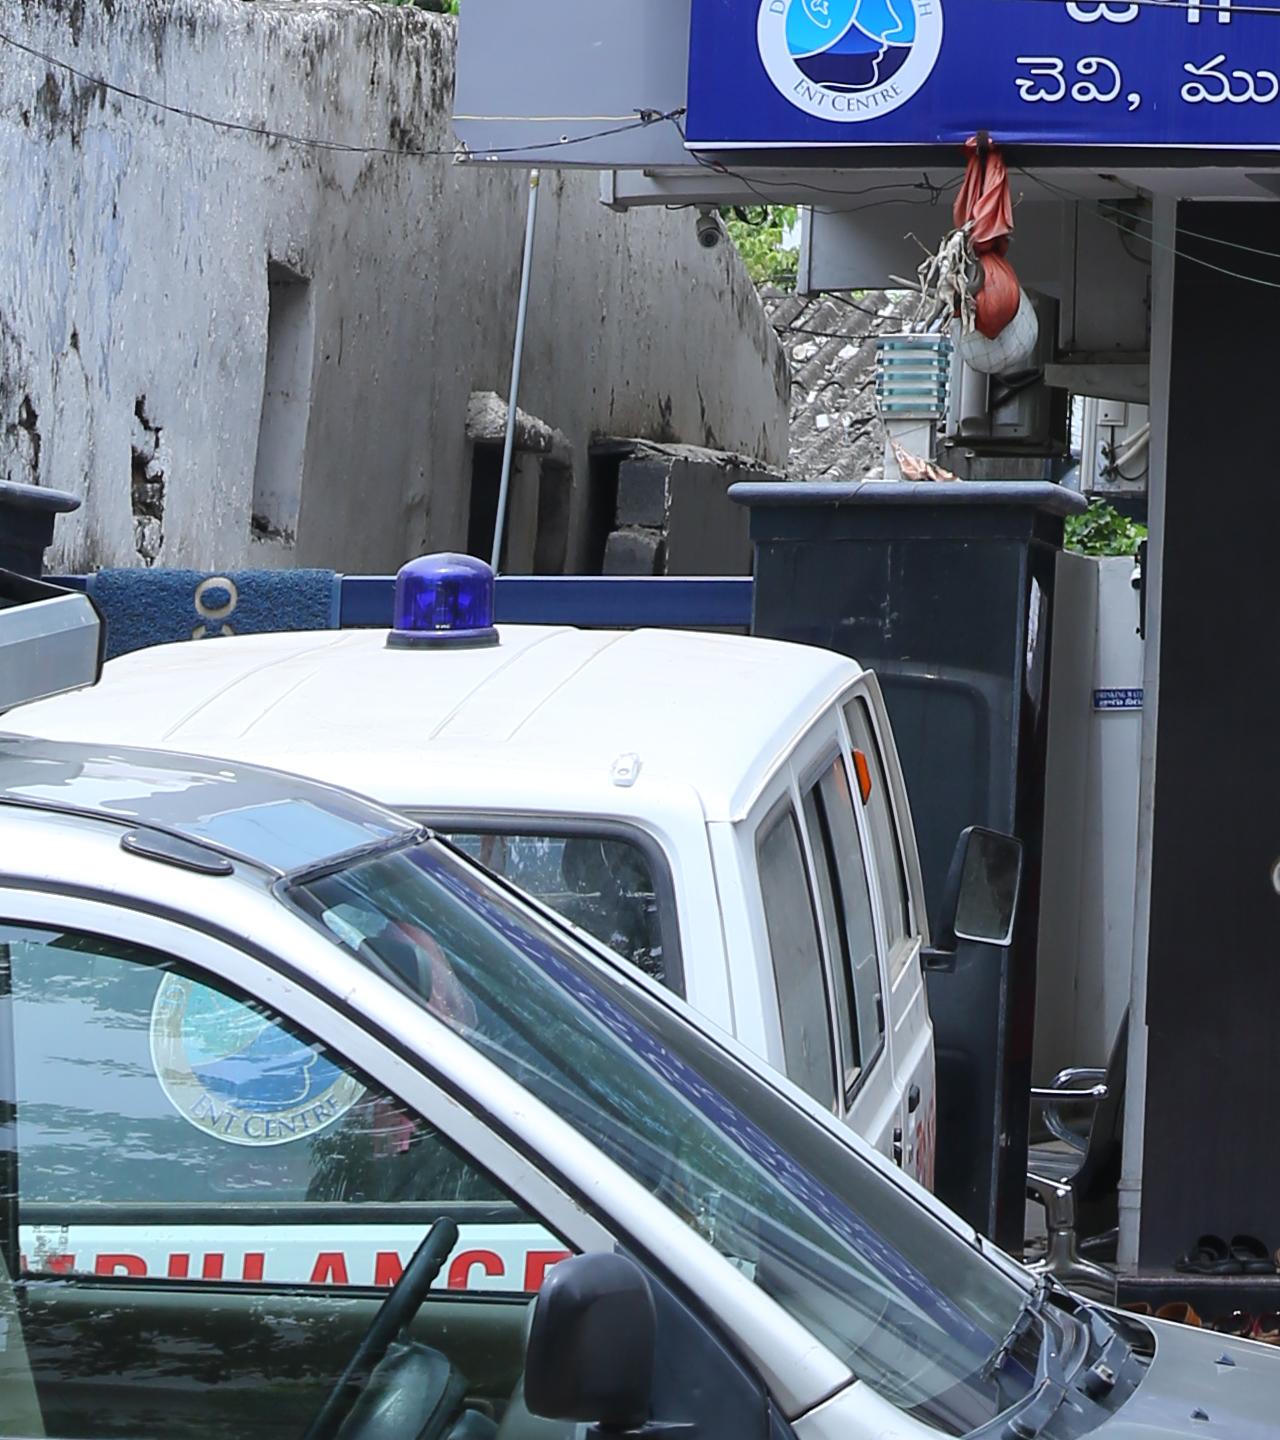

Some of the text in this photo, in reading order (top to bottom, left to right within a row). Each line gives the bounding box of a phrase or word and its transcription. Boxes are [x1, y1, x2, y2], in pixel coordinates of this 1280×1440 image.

[793, 78, 903, 112] ENT CENTRE
[1014, 56, 1141, 111] చెవి,
